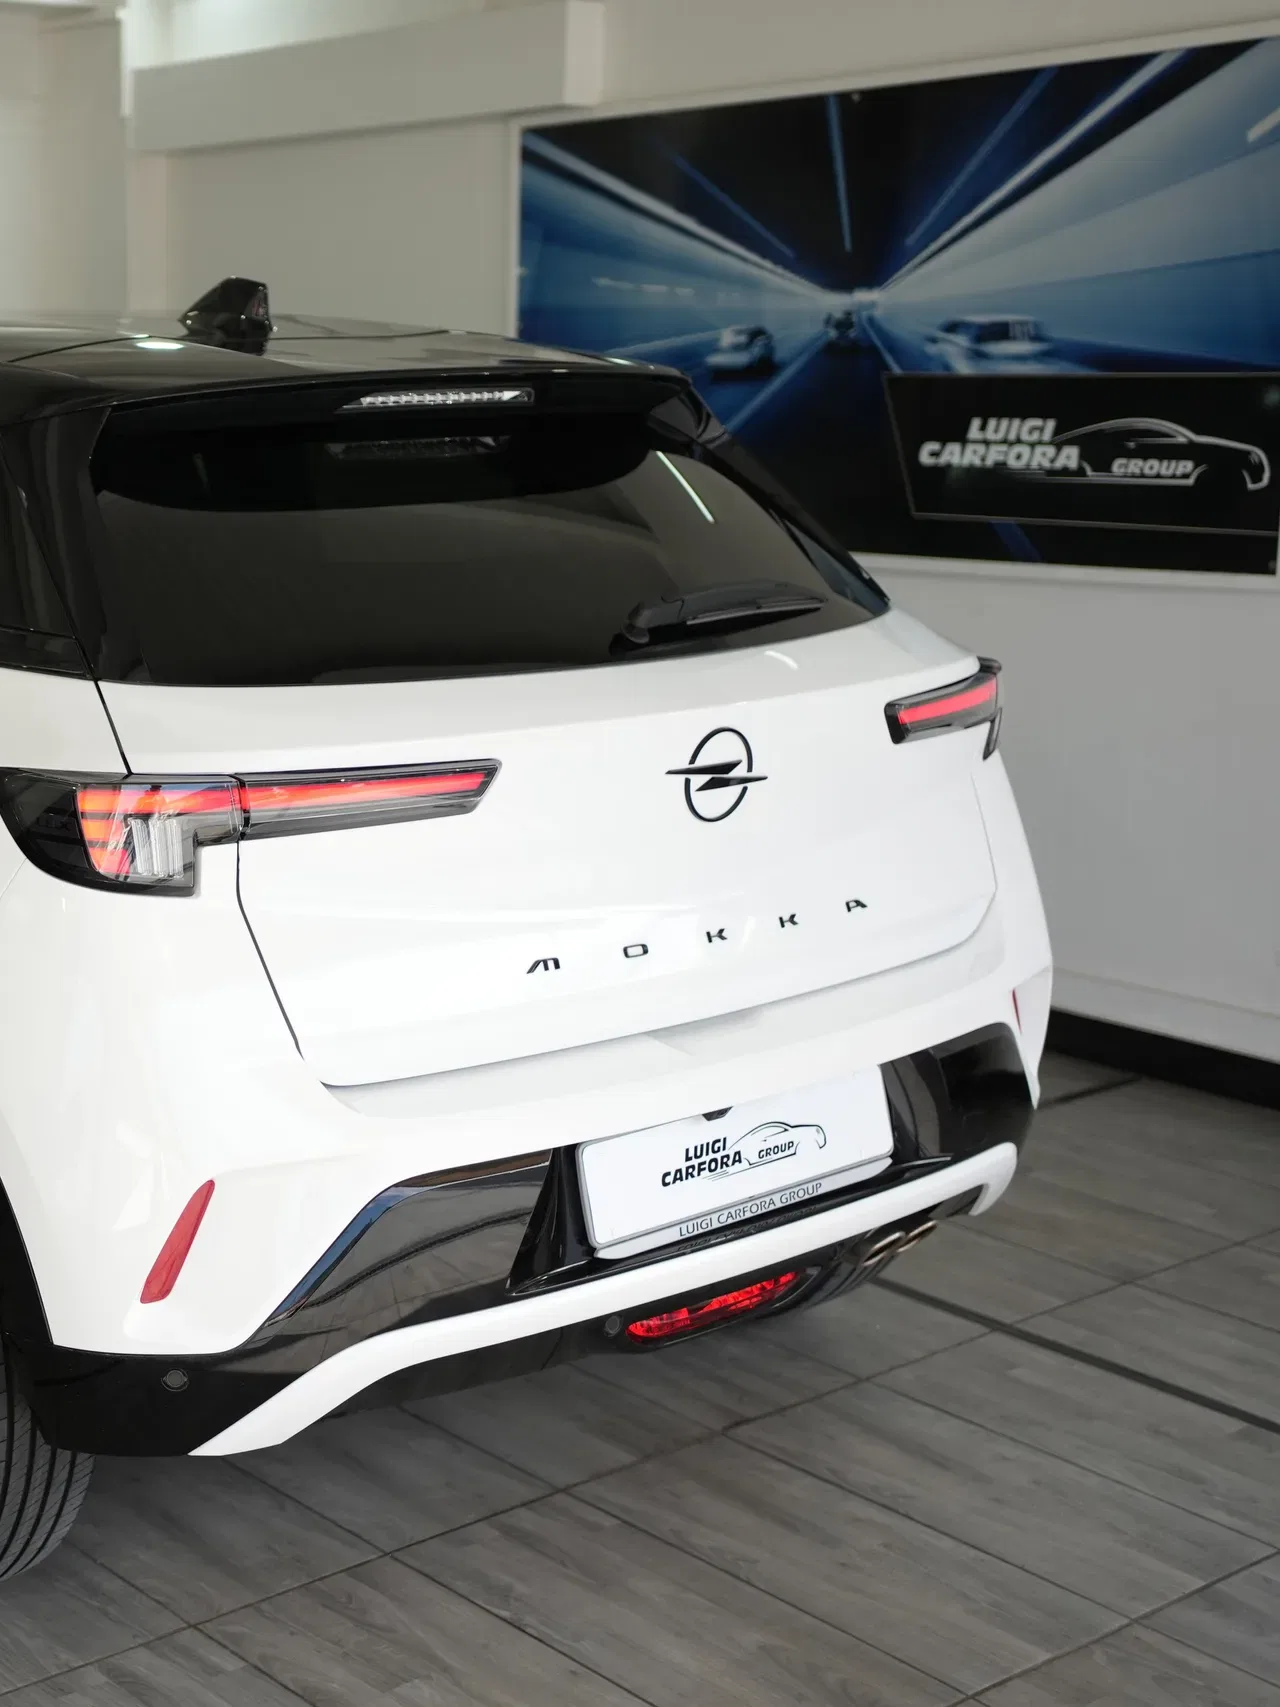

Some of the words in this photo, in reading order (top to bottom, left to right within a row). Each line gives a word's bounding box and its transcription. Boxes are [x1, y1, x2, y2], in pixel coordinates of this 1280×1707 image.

[965, 416, 1058, 442] LUIGI
[918, 441, 1080, 471] CARFORA
[1111, 457, 1195, 478] GROUP
[526, 898, 868, 974] MOKKA
[661, 1150, 743, 1188] CARFORA
[757, 1140, 795, 1160] GROUP
[684, 1136, 728, 1163] LUIGI
[679, 1217, 714, 1238] LUIGI
[717, 1198, 777, 1225] CARFORA
[779, 1182, 822, 1204] GROUP
